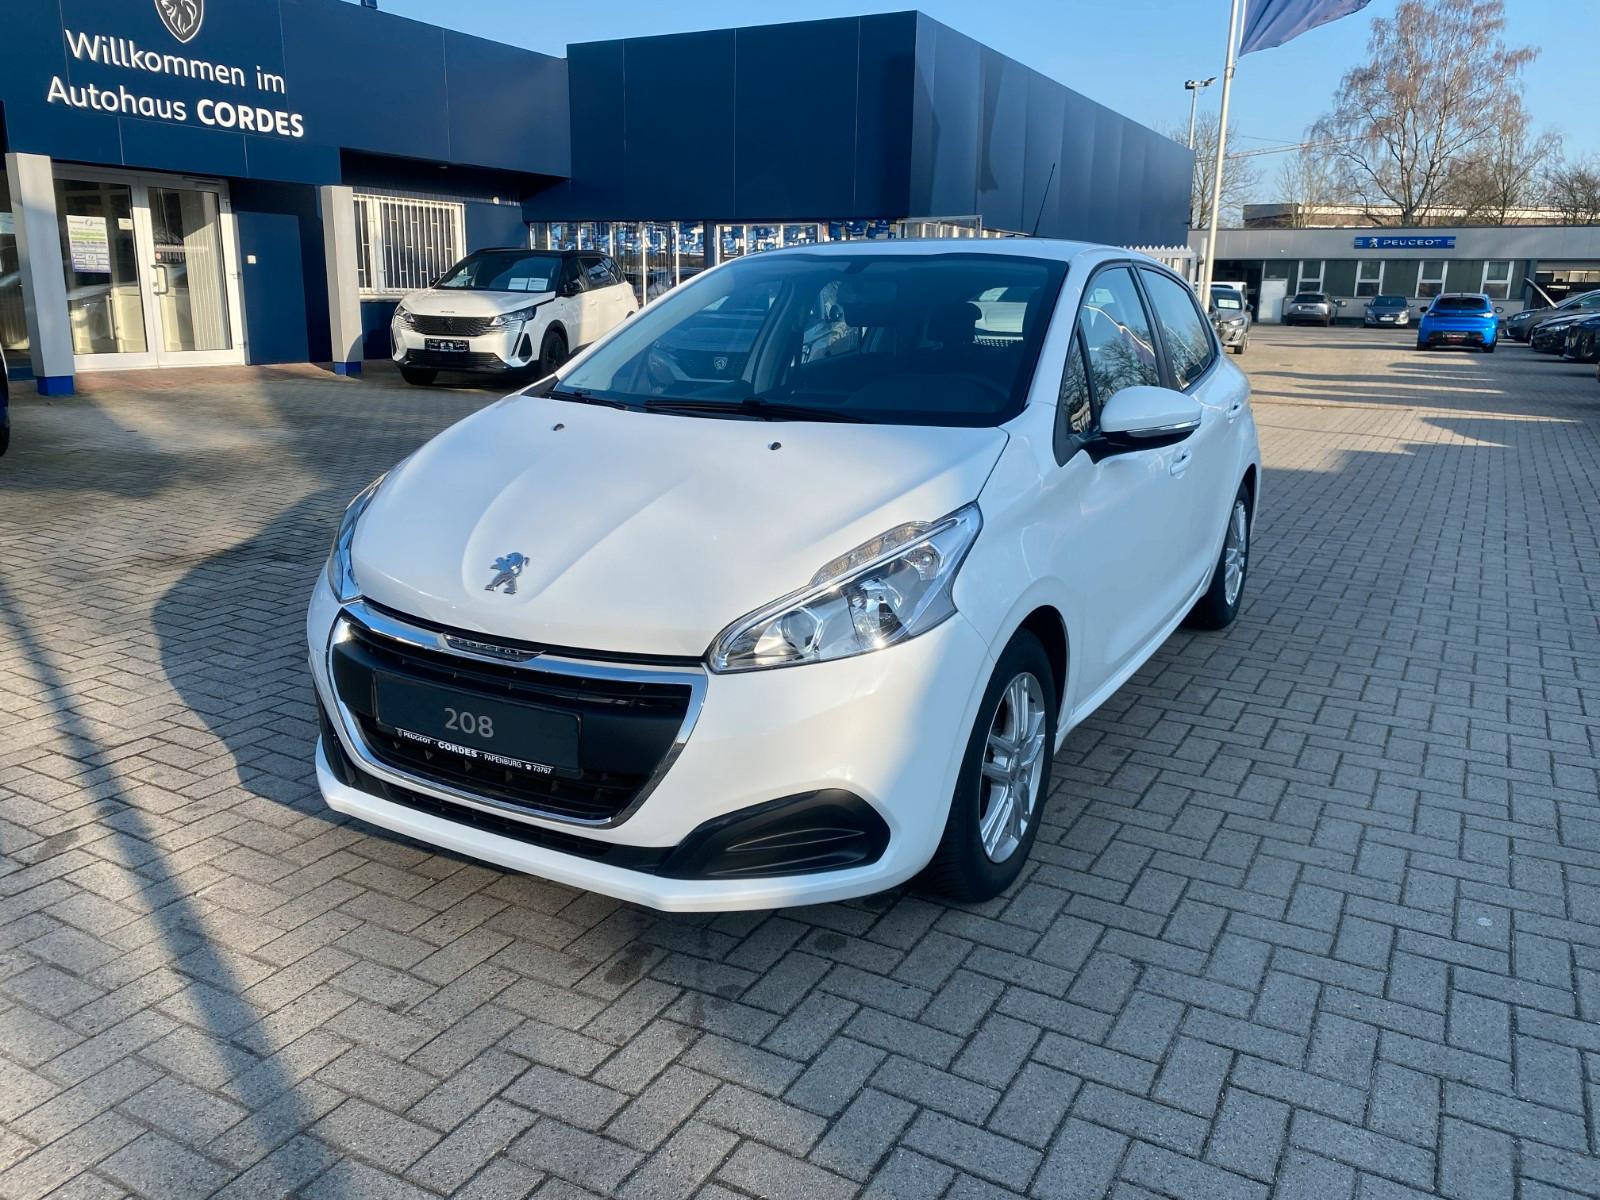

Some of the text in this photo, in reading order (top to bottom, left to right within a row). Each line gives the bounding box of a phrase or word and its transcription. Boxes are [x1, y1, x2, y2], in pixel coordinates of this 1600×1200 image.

[65, 29, 285, 94] Willkommen im
[47, 76, 304, 138] Autohaus CORDES
[444, 707, 494, 738] 208
[403, 731, 431, 745] PEUGEOT
[437, 741, 478, 758] CORDES
[484, 753, 522, 769] PAPENBURG
